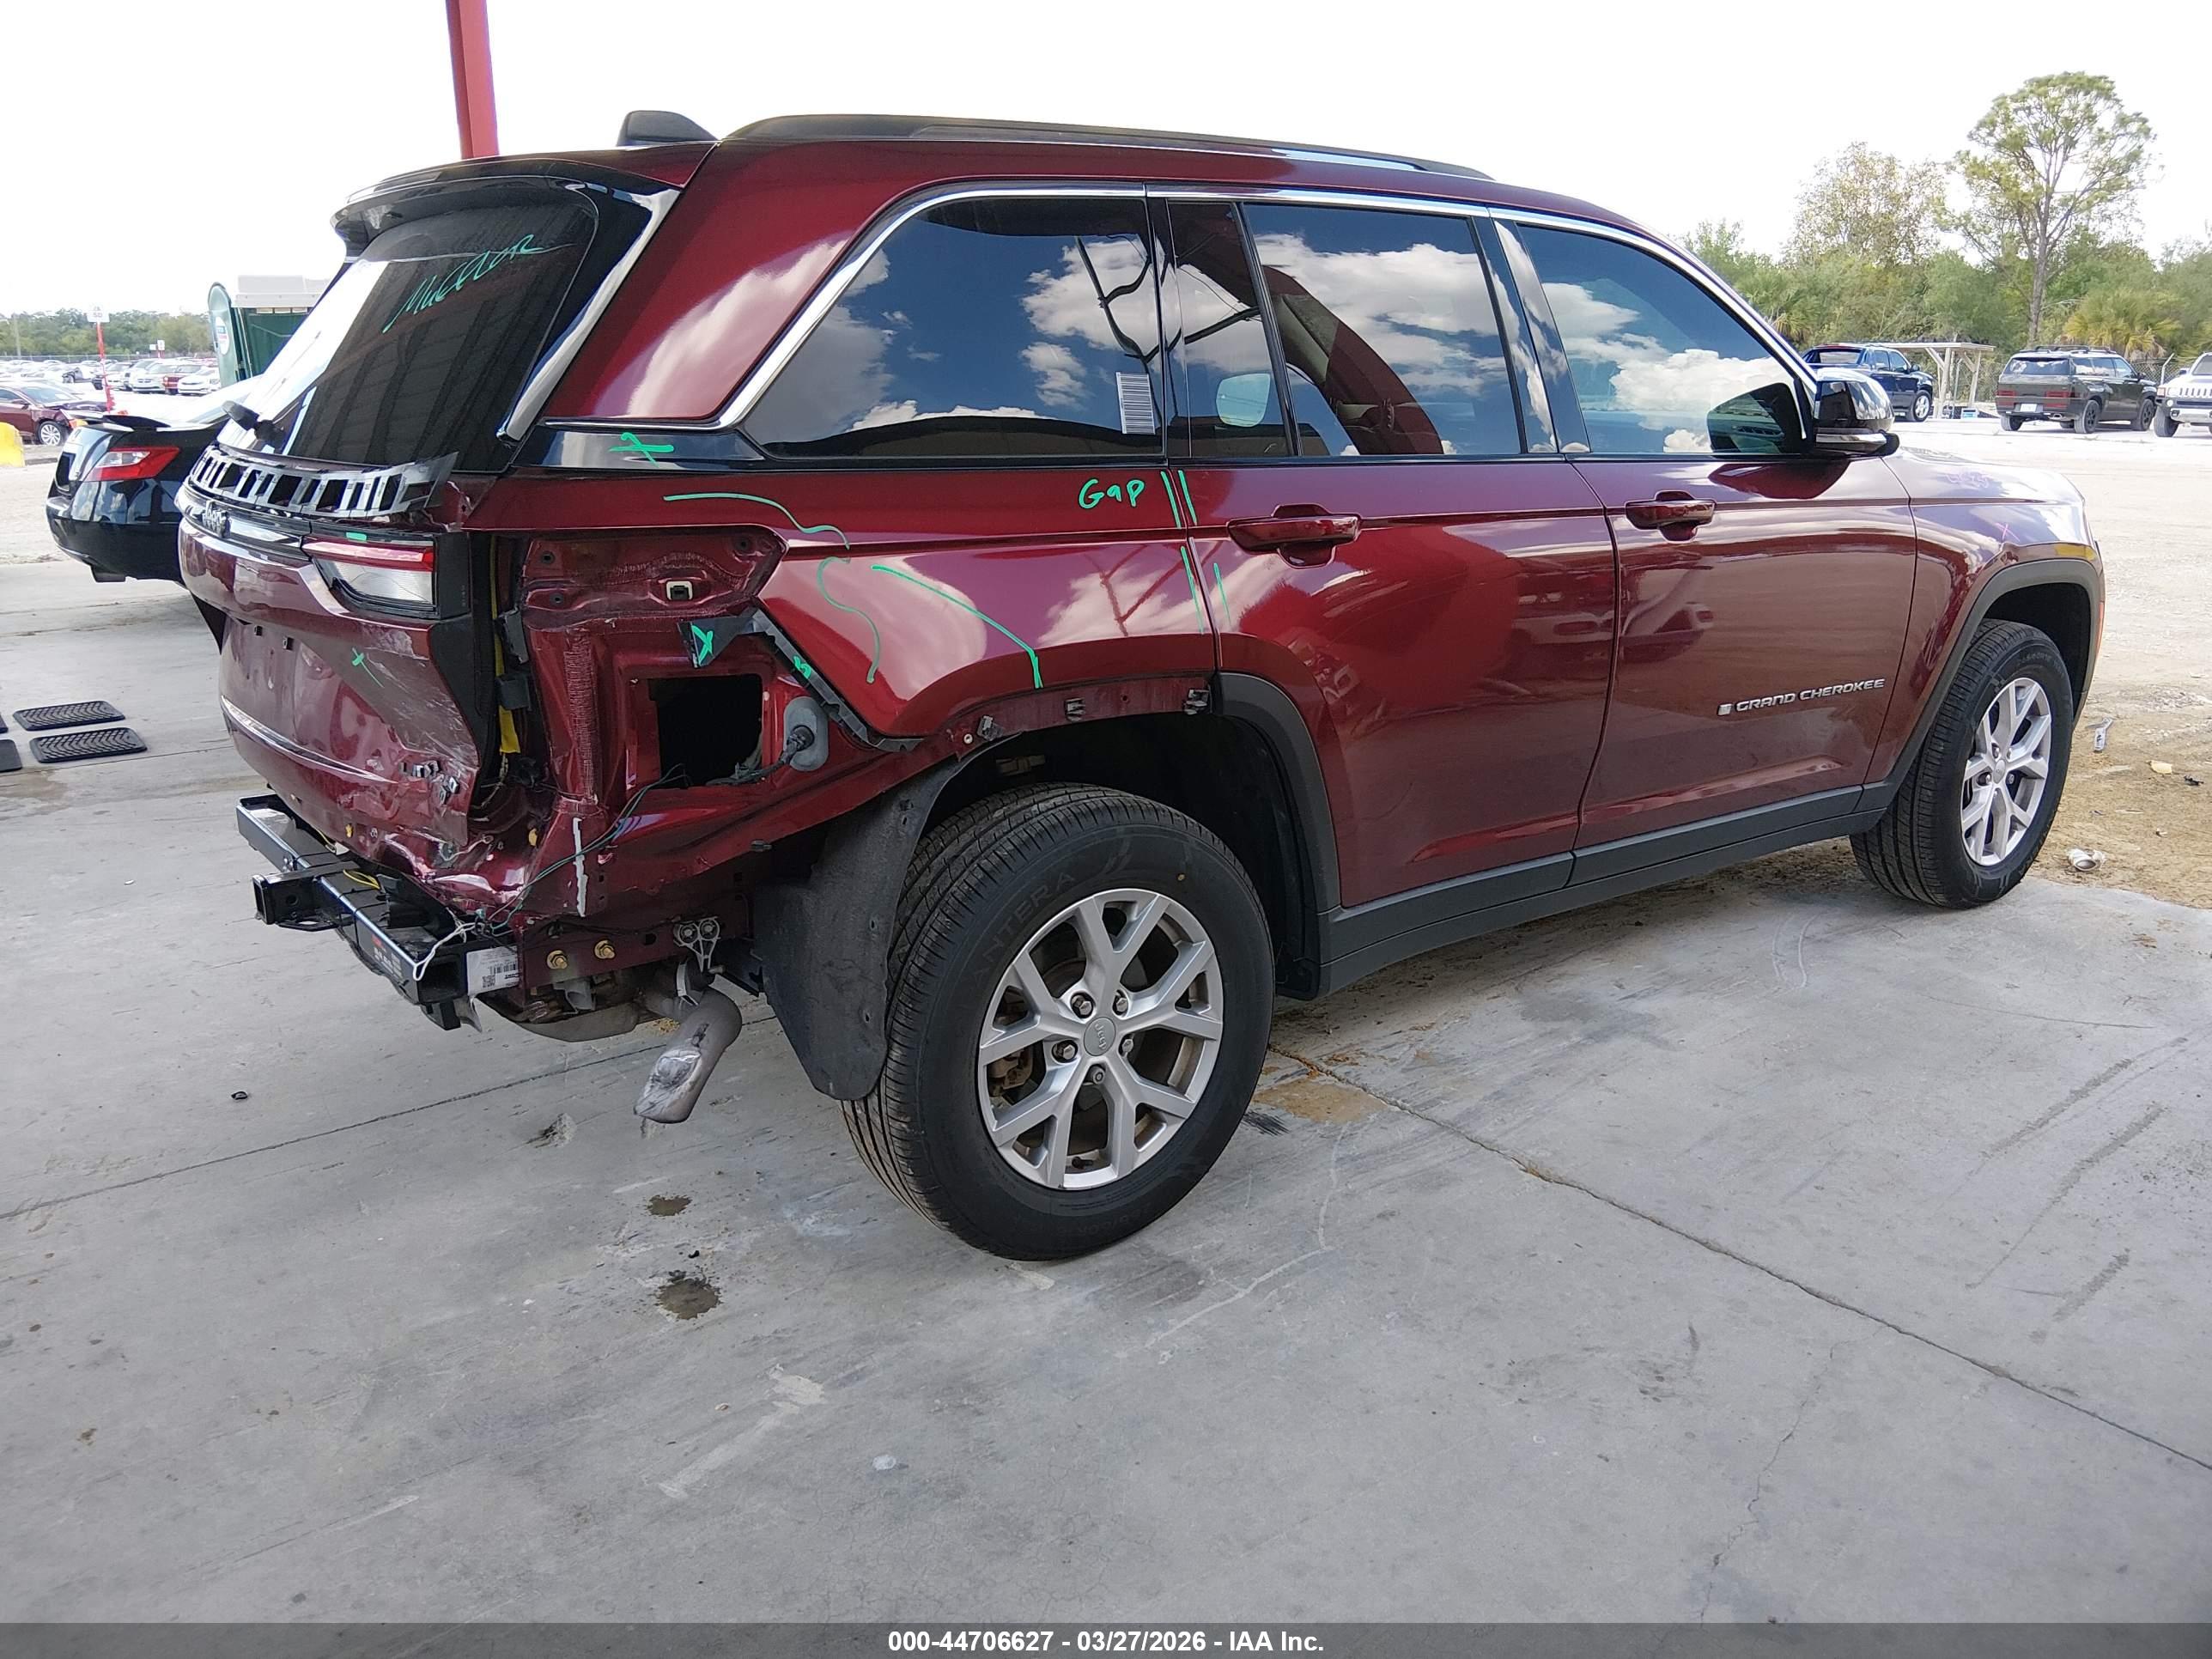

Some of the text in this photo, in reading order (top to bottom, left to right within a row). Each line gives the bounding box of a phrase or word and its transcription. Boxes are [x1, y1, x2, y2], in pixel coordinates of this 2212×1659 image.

[1735, 678, 1886, 712] GRAND CHEROKEE
[1094, 1023, 1107, 1050] Jeep
